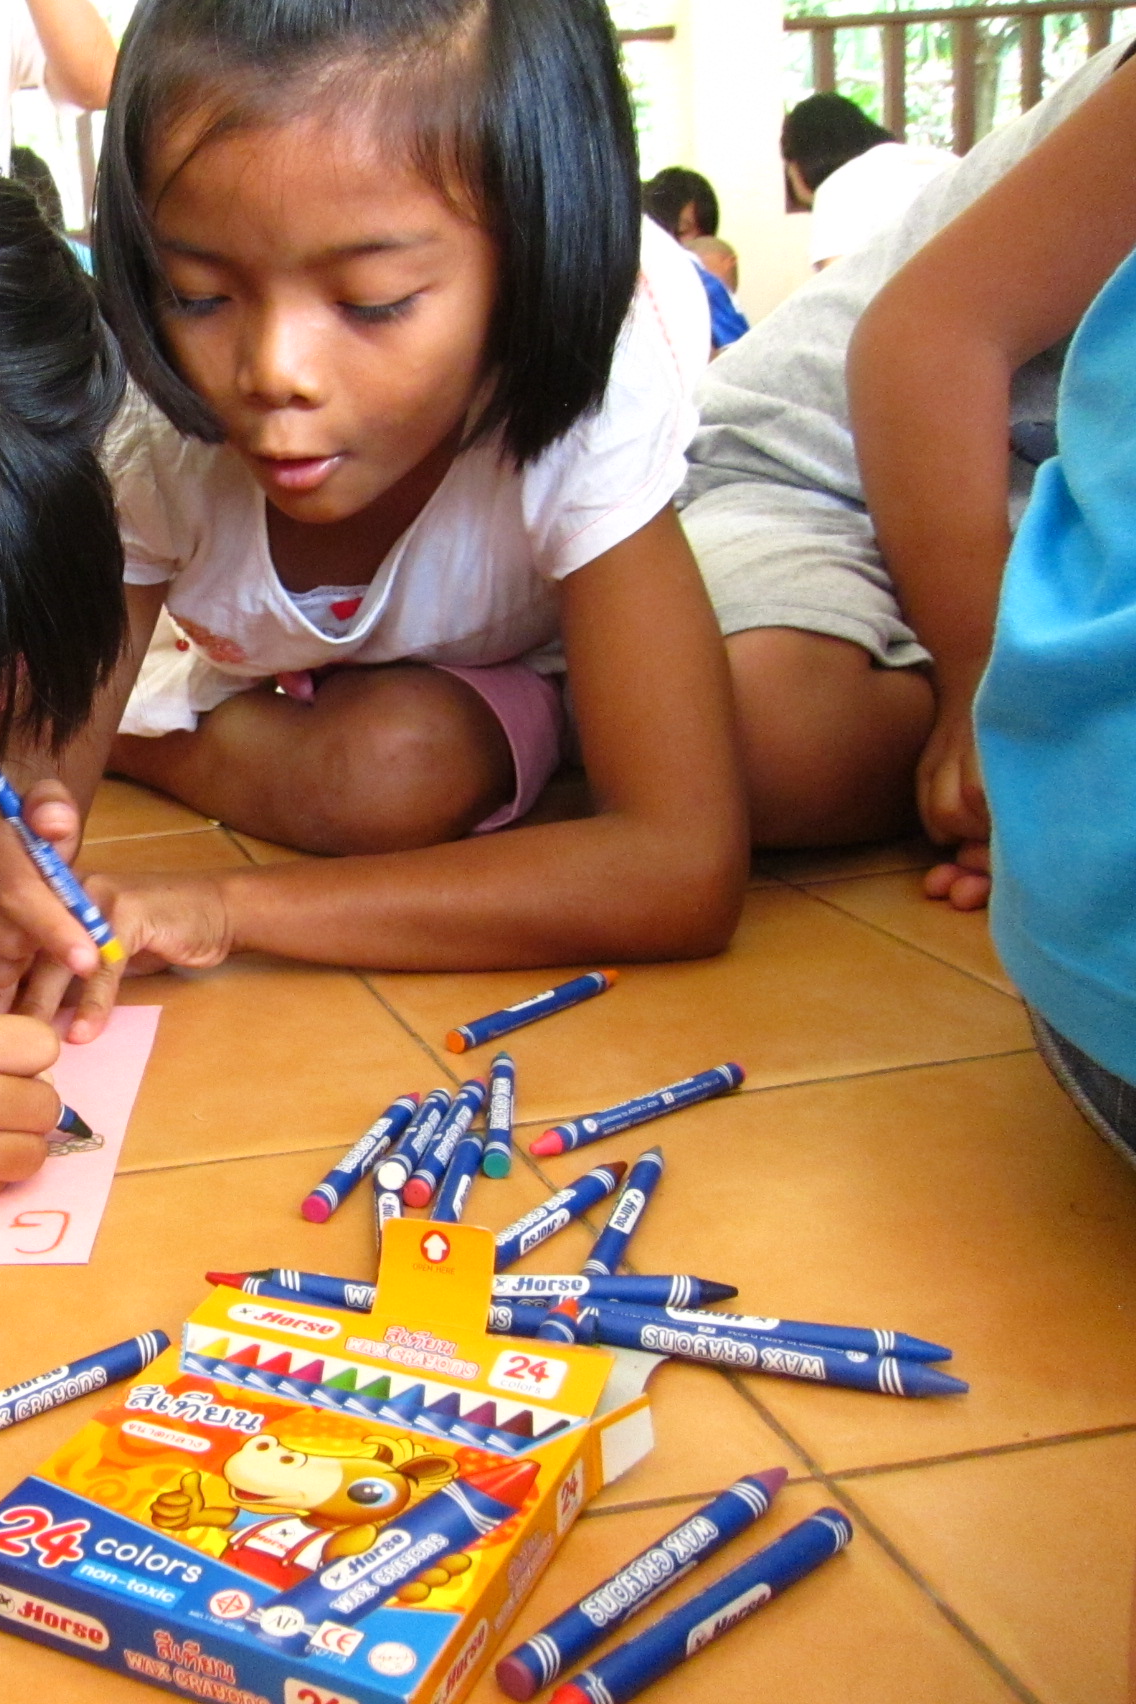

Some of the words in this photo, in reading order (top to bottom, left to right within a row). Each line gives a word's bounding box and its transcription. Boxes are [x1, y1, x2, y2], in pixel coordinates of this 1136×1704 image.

[511, 1276, 583, 1292] Horse
[253, 1309, 336, 1336] Horse
[384, 1325, 459, 1357] สีเทียน
[345, 1336, 390, 1360] WAX
[388, 1346, 480, 1381] CRAYONS
[503, 1355, 550, 1383] 24
[761, 1347, 826, 1380] WAX
[500, 1378, 542, 1395] colors
[125, 1384, 265, 1434] สีเทียน
[348, 1534, 405, 1576] Horse
[661, 1515, 720, 1561] WAX
[95, 1537, 203, 1584] colors
[79, 1562, 177, 1604] non-toxic
[329, 1579, 381, 1615] WAX
[17, 1600, 106, 1645] Horse
[123, 1648, 173, 1683] WAX
[153, 1628, 237, 1686] สีเทียน
